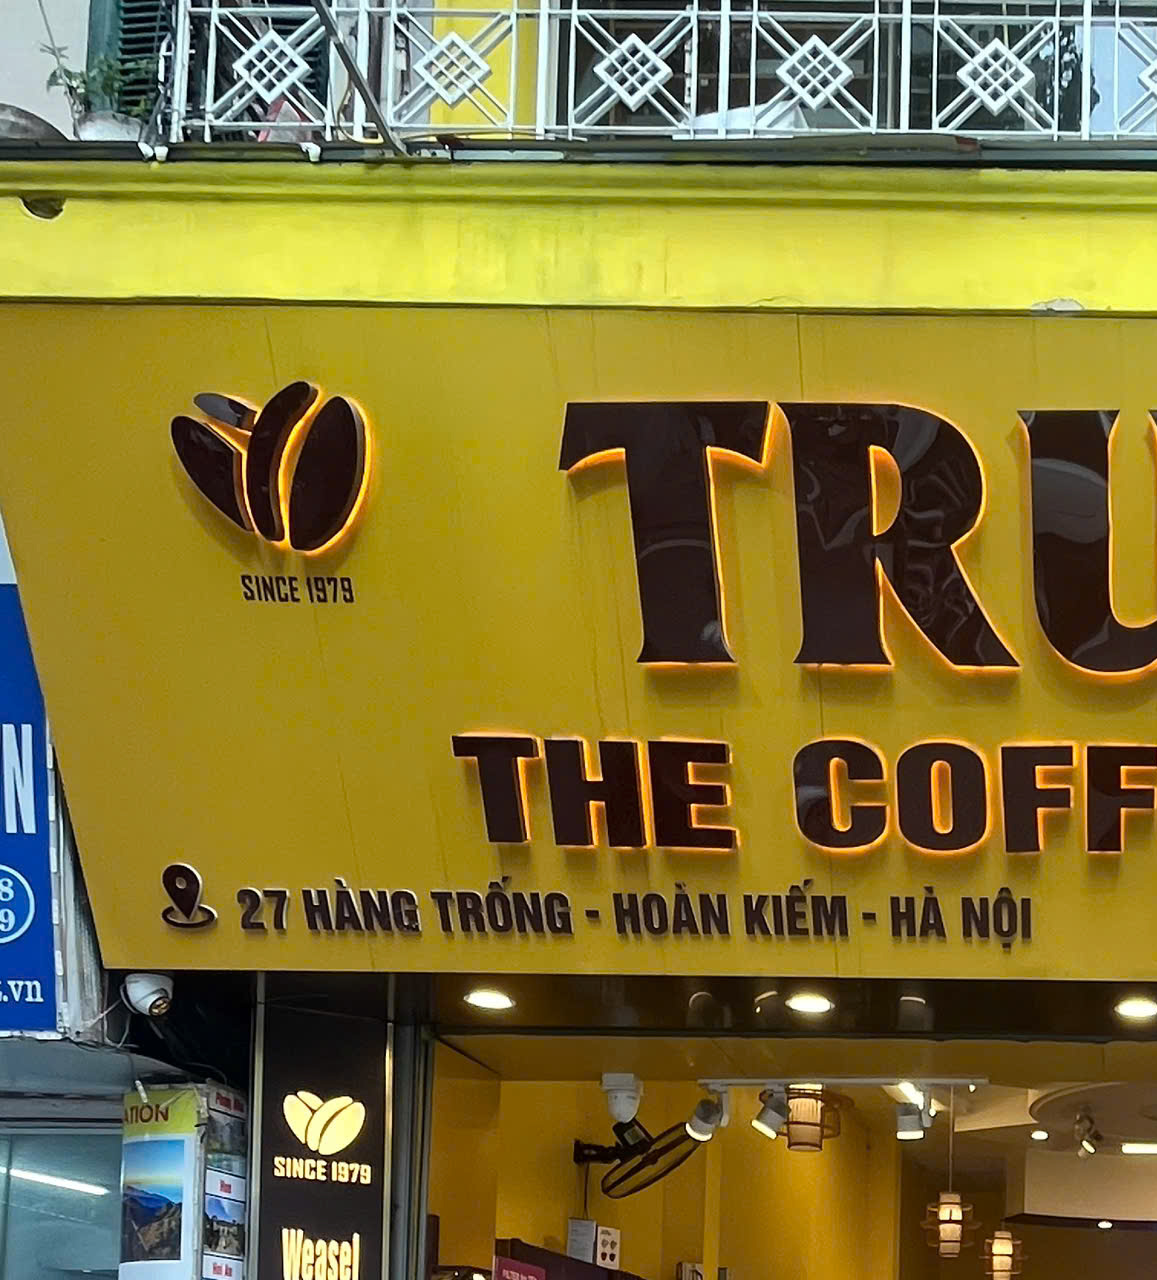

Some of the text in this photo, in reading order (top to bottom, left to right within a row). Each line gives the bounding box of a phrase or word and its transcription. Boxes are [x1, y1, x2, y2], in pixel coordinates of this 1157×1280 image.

[242, 575, 354, 604] SINCE 1979
[452, 736, 739, 848] THE
[237, 888, 290, 931] 27
[302, 876, 422, 933] HÀNG
[430, 875, 574, 935] TRỐNG
[613, 881, 731, 936] HOÀN
[744, 879, 849, 938] KIẾM
[890, 886, 947, 938] HÀ
[962, 886, 1032, 953] NỘI
[0, 979, 44, 1002] .vn
[274, 1156, 372, 1185] SINCE 1979
